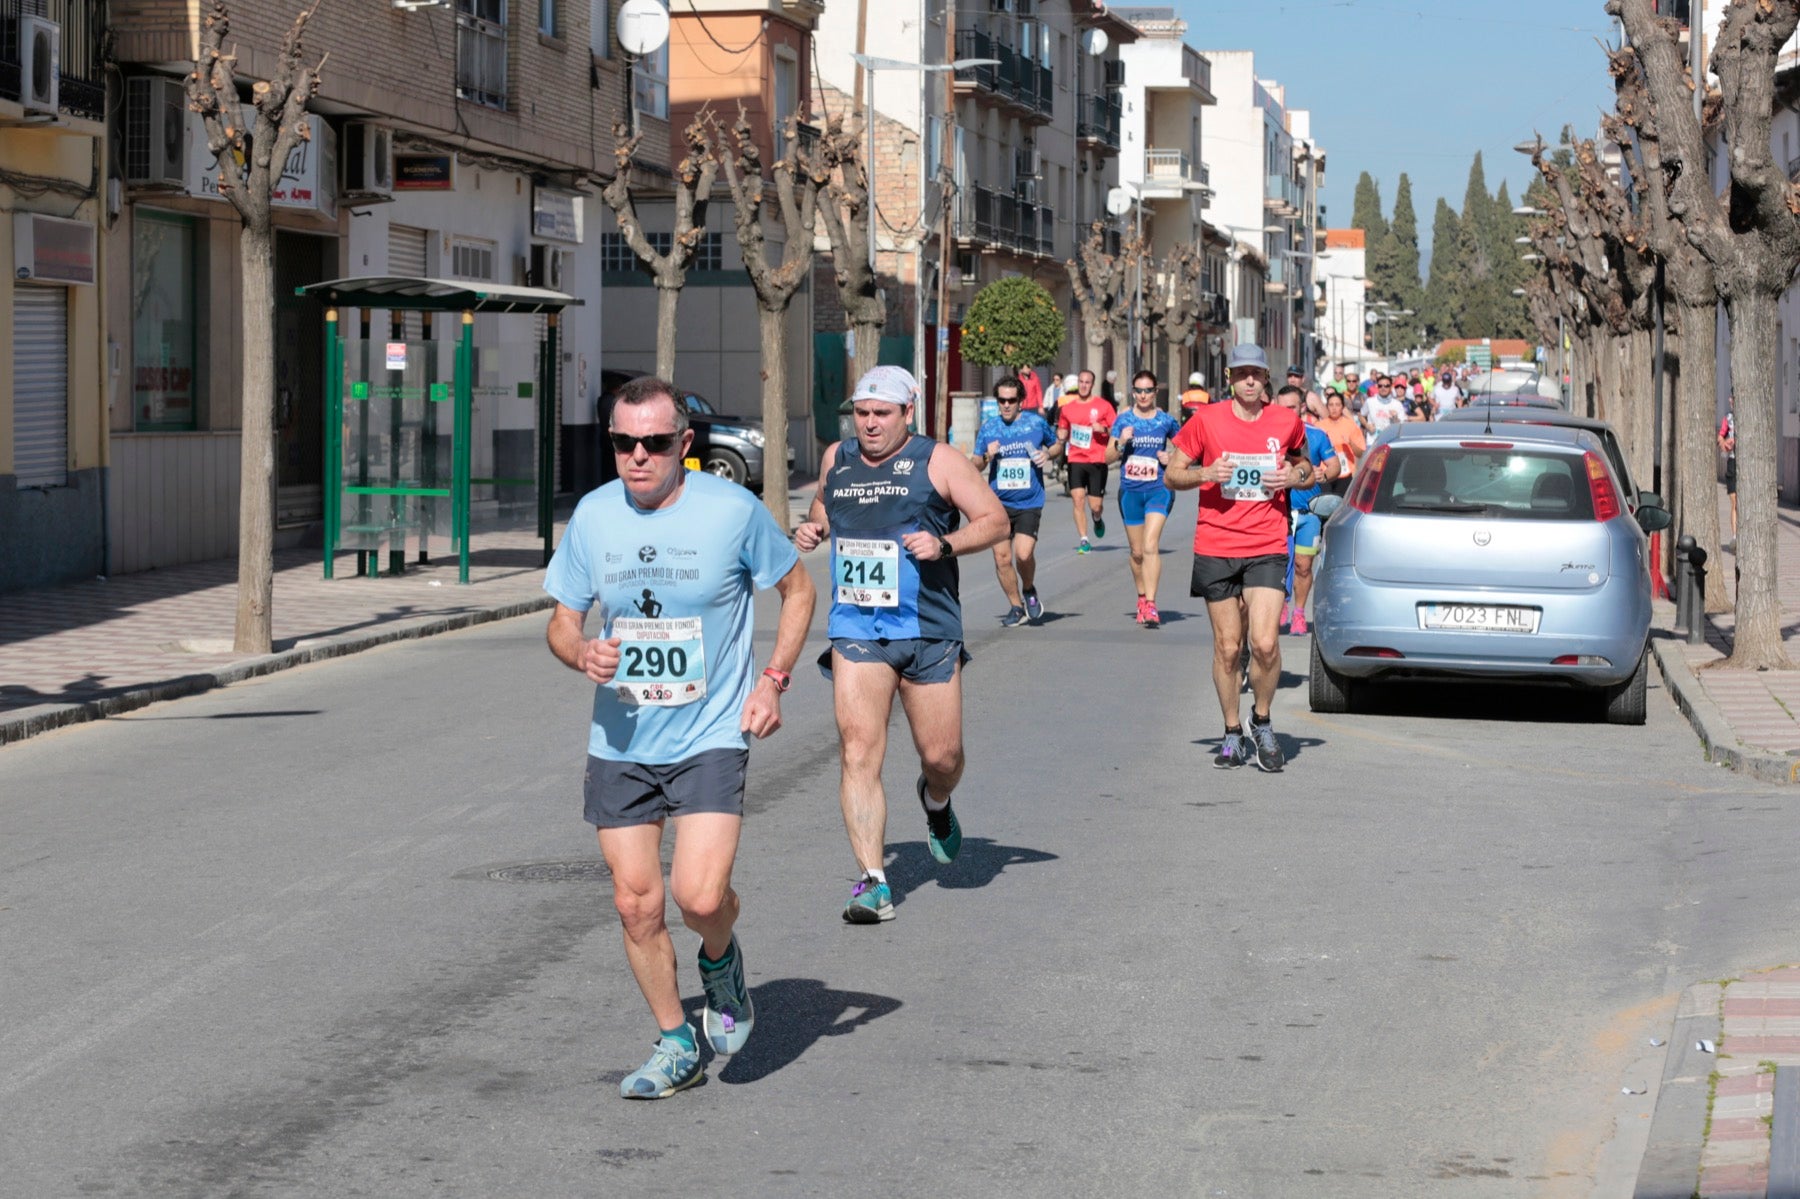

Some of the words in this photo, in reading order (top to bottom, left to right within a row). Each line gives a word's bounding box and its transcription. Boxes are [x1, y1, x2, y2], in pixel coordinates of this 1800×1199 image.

[1002, 468, 1025, 479] 489
[1237, 469, 1261, 486] 99
[833, 487, 865, 498] PAZITO
[874, 486, 909, 496] PAZITO
[858, 496, 879, 504] Motril
[618, 569, 637, 583] GRAN
[638, 566, 665, 579] PREMIO
[665, 567, 675, 579] DE
[675, 568, 700, 580] FONDO
[843, 560, 886, 585] 214
[628, 621, 644, 630] GRAN
[644, 621, 665, 630] PREMIO
[666, 621, 673, 630] DE
[675, 620, 695, 630] FONDO
[1441, 606, 1488, 624] 7023
[1495, 608, 1528, 627] FNL
[625, 646, 688, 678] 290
